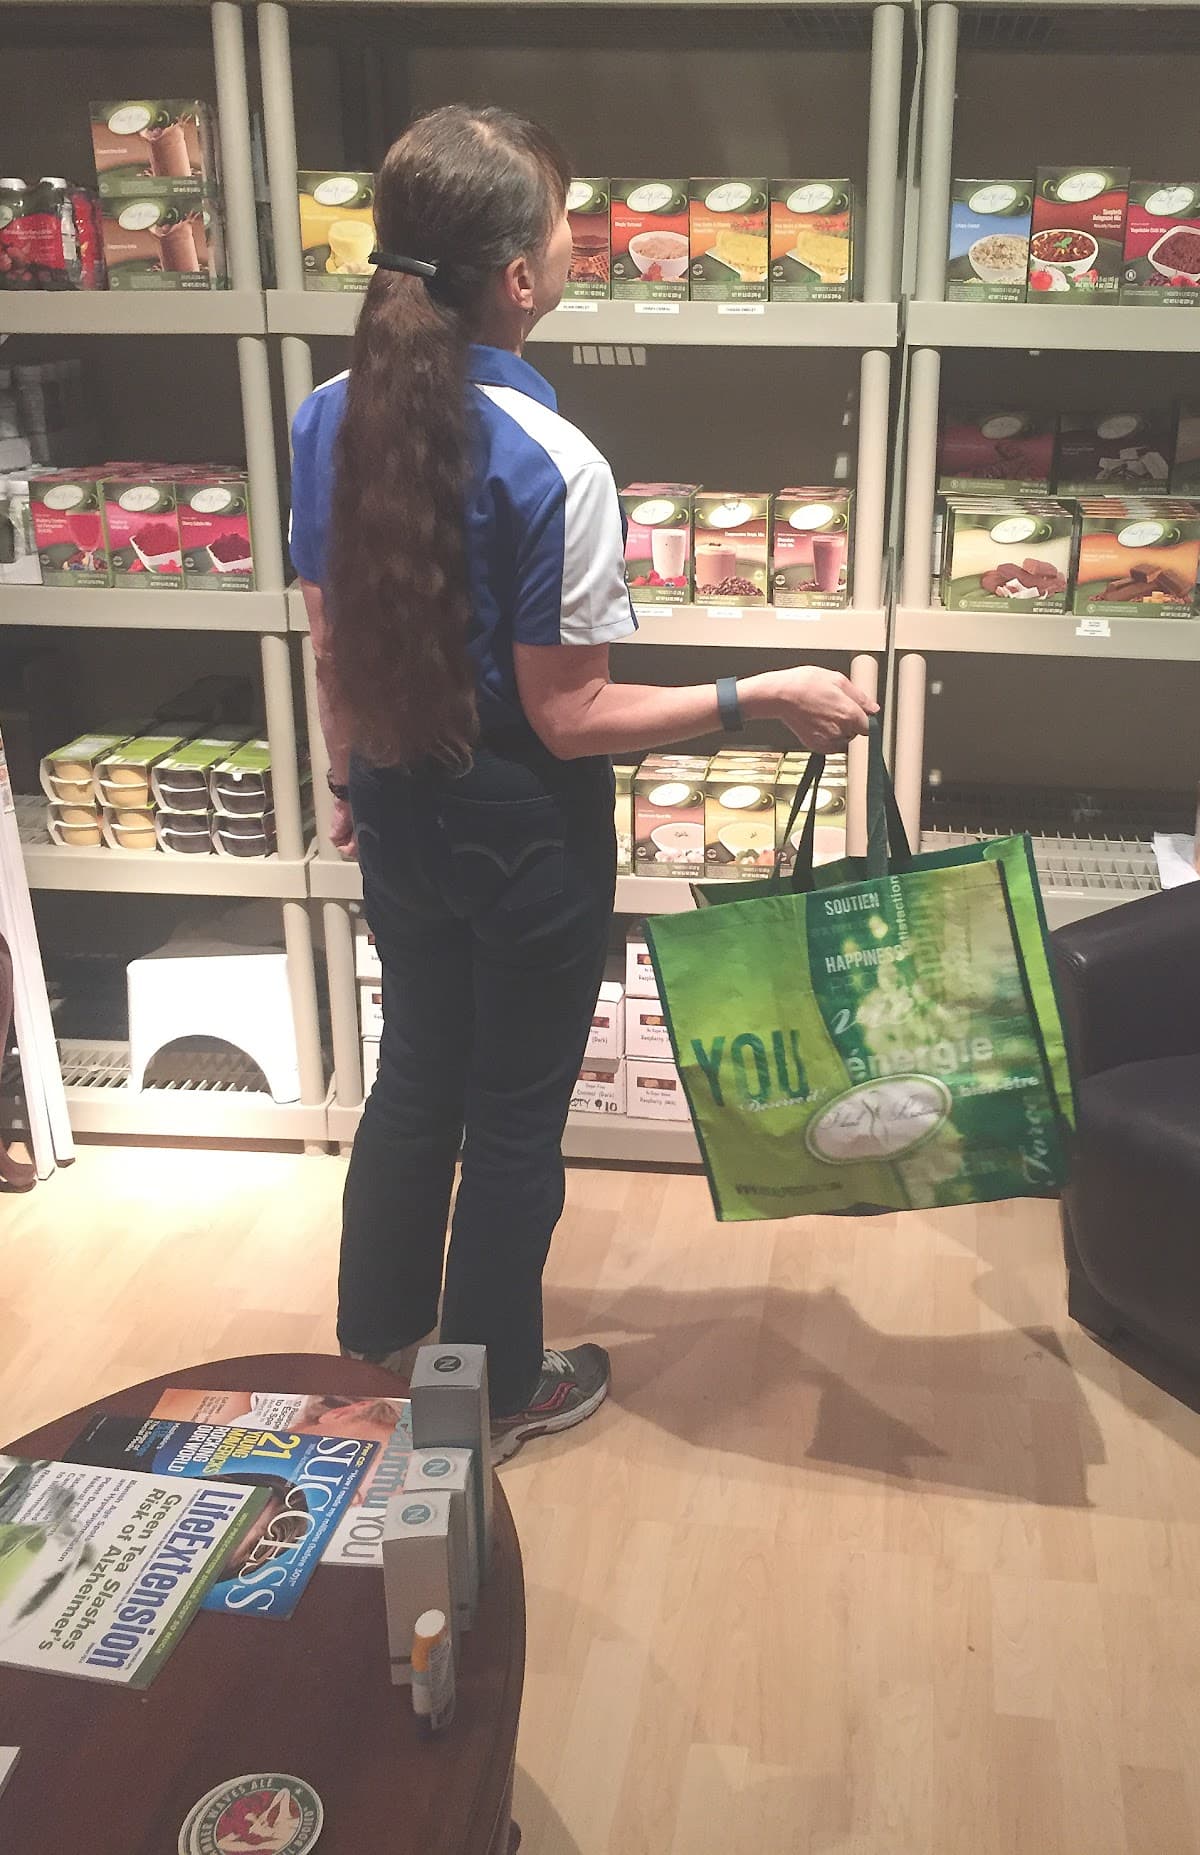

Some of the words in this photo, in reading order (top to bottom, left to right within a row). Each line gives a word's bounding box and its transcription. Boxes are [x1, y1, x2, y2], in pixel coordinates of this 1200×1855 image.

[824, 892, 880, 916] SOUTIEN
[691, 1030, 810, 1107] YOU
[189, 1424, 208, 1442] OUR
[191, 1426, 230, 1462] ROCKING
[230, 1429, 263, 1458] YOUNG
[250, 1432, 302, 1459] 21
[166, 1441, 201, 1472] WORLD
[201, 1427, 244, 1474] MAVERICKS
[76, 1475, 101, 1500] Natural
[92, 1477, 112, 1495] Plant
[101, 1504, 117, 1518] Age
[130, 1487, 167, 1520] Risk
[136, 1493, 184, 1539] Green
[115, 1524, 137, 1541] of
[221, 1436, 363, 1612] SUCCESS
[312, 1518, 330, 1542] millions
[341, 1514, 387, 1558] YOU
[113, 1543, 147, 1573] Tea
[84, 1489, 244, 1669] LifeExtension
[36, 1544, 124, 1651] Alzheimer's
[59, 1578, 123, 1651] Slashes
